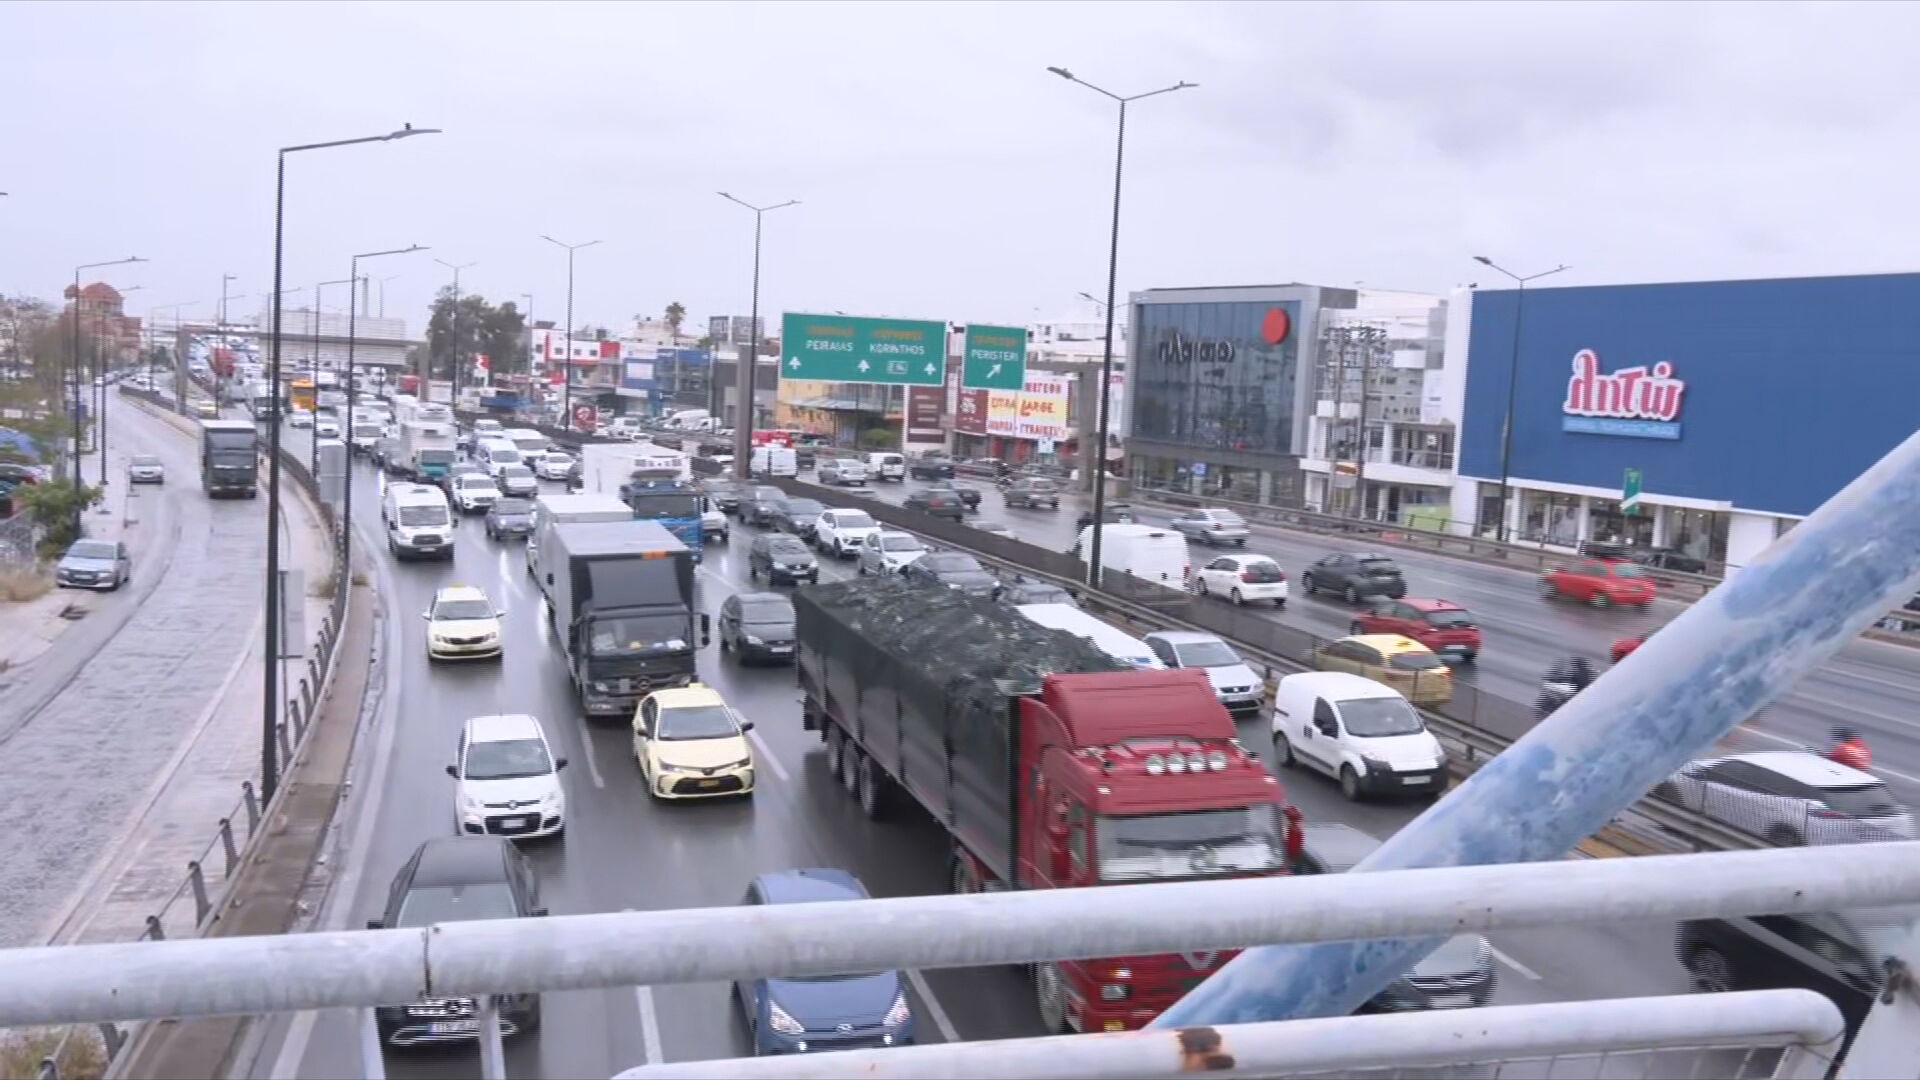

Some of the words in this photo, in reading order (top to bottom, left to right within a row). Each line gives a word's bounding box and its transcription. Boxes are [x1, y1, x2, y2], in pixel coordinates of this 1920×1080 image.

[869, 343, 925, 355] KORINTHOS
[971, 349, 1019, 362] PERISTERI
[1020, 399, 1056, 417] LARGE
